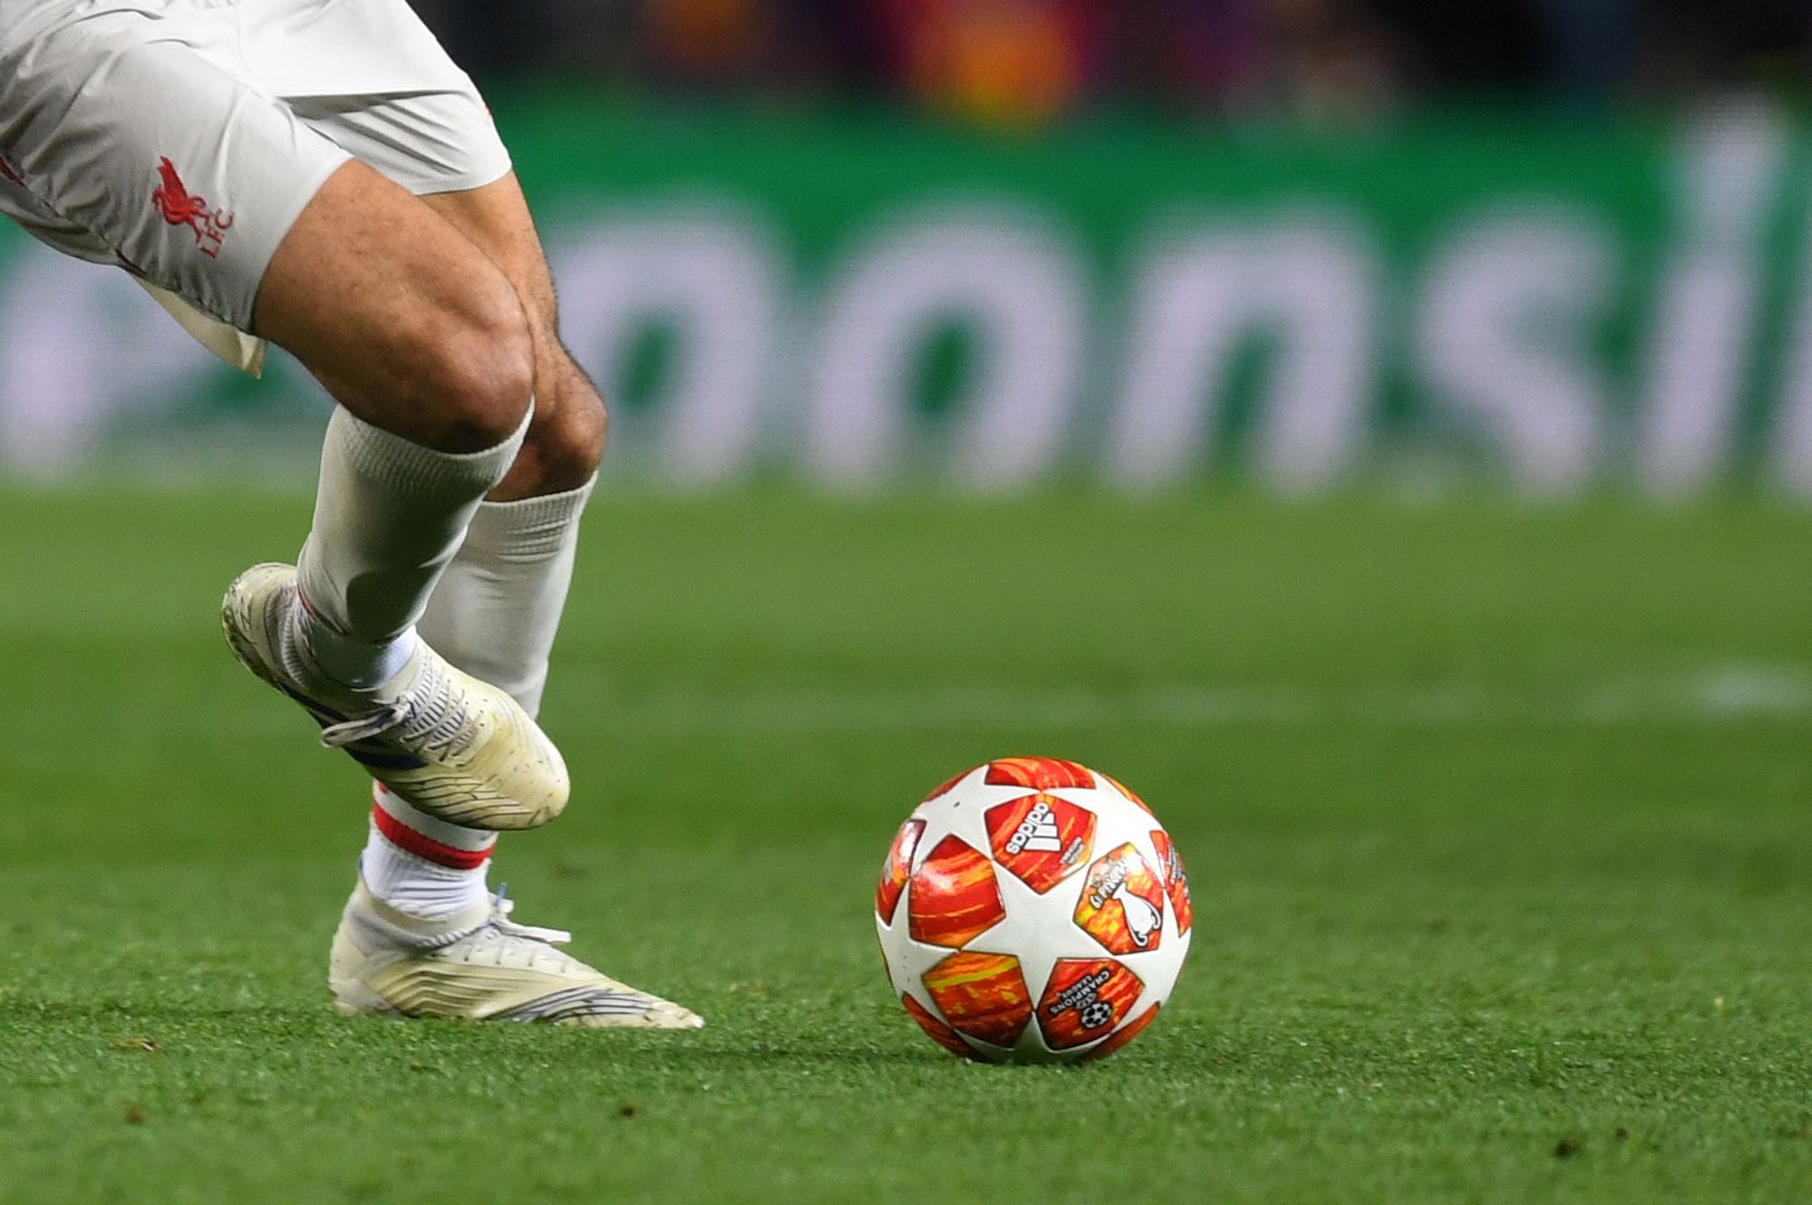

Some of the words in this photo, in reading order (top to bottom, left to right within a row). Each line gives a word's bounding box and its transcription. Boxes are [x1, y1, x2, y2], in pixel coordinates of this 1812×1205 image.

[200, 208, 234, 259] LFC
[1005, 802, 1049, 855] adidas
[1049, 970, 1110, 1014] CHAMPIONS
